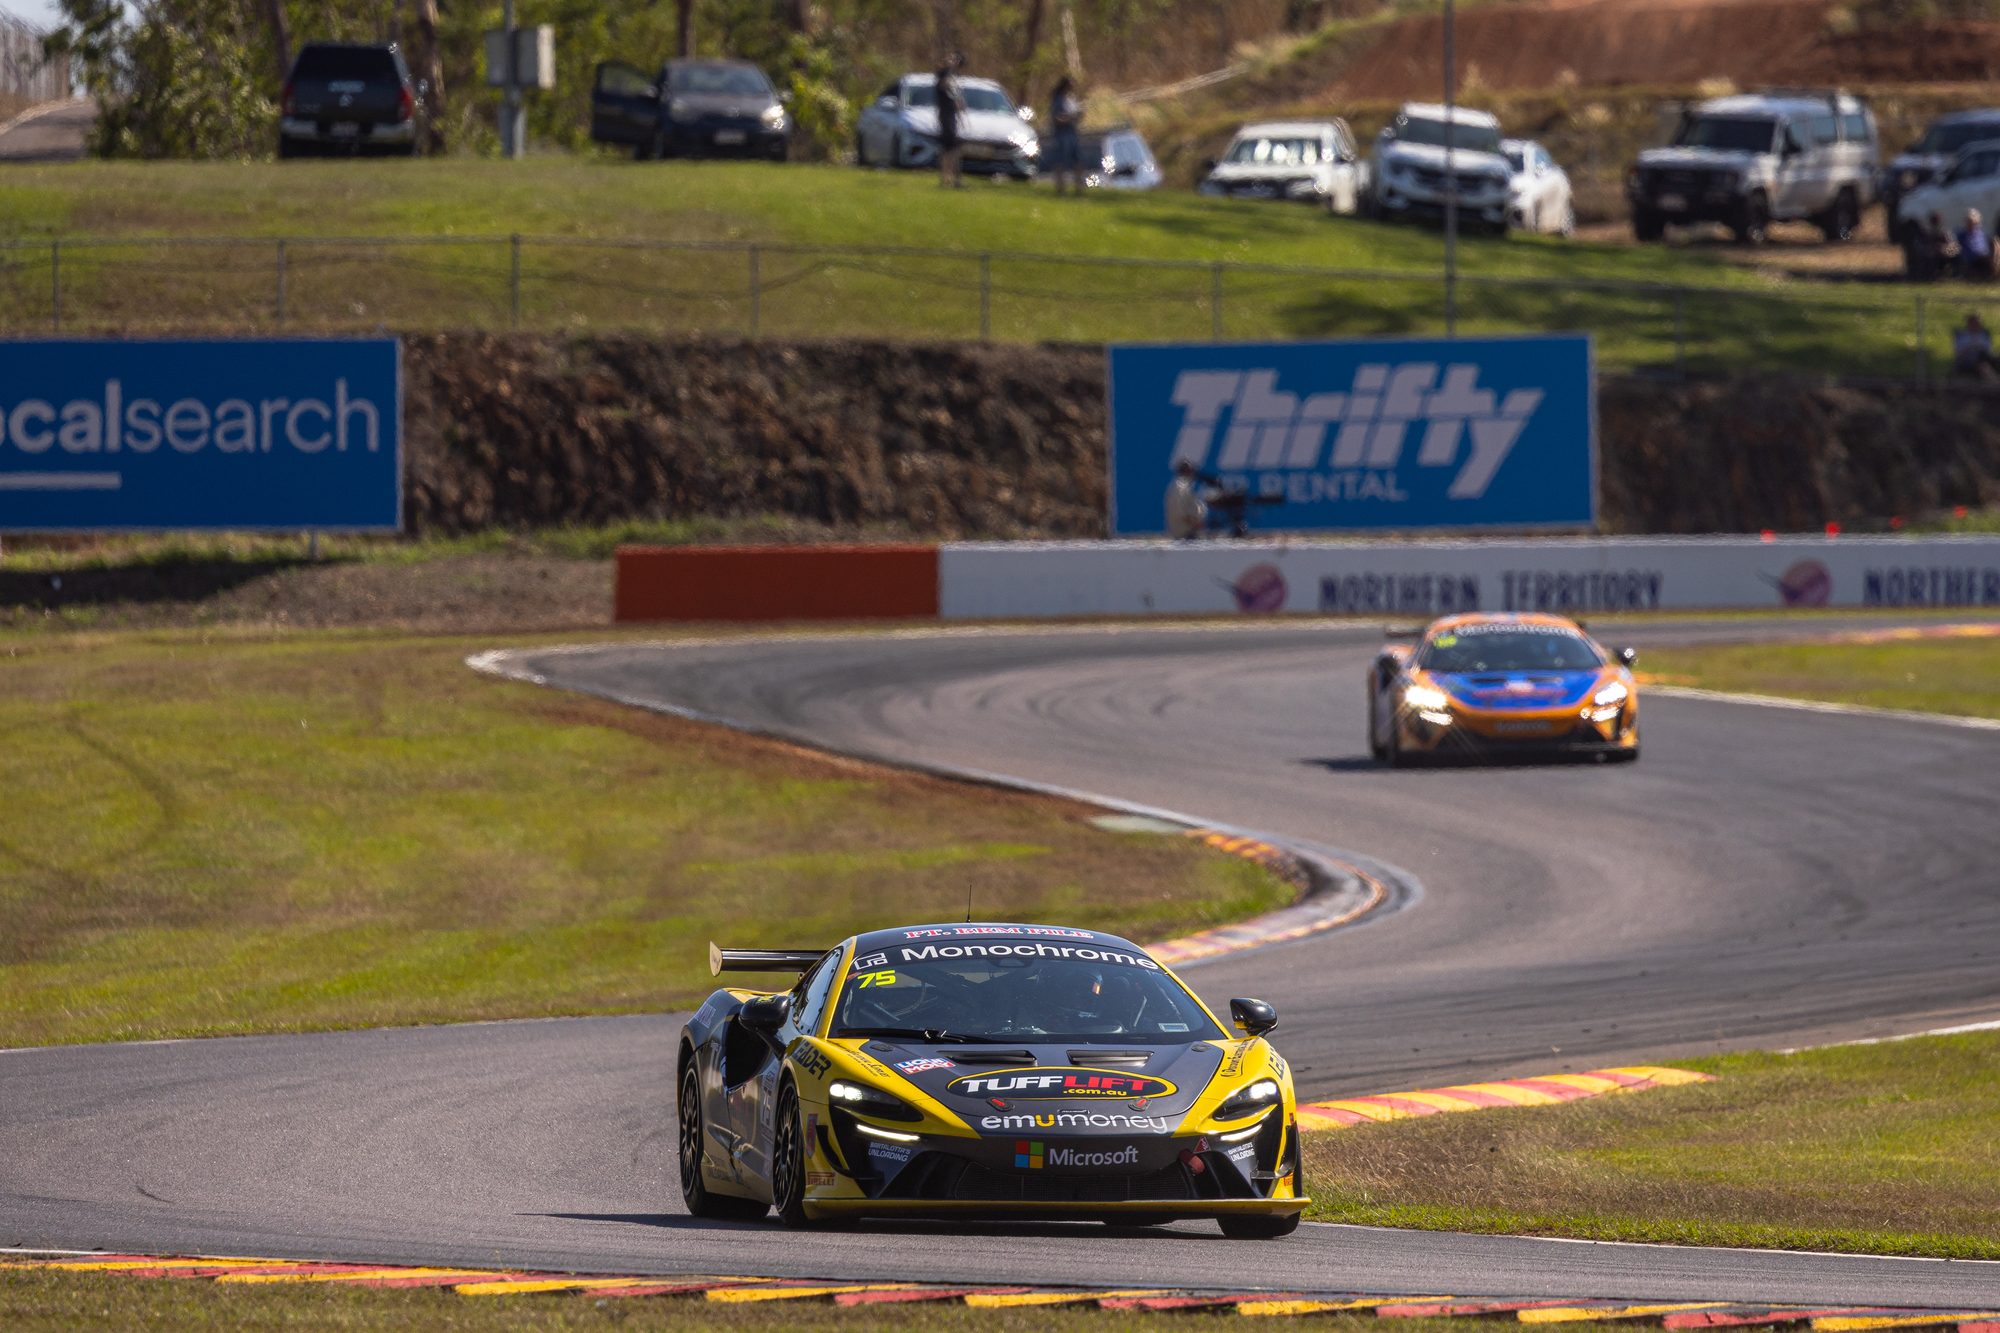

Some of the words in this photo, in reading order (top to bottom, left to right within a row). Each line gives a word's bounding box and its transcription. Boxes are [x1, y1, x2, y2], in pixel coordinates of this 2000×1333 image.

[0, 377, 380, 453] calsearch
[1168, 363, 1546, 499] Thrifty
[1258, 470, 1408, 503] RENTAL
[901, 943, 1158, 969] Monochrome
[857, 969, 896, 989] 75
[904, 1063, 953, 1074] MOLY
[1063, 1088, 1127, 1096] .com.au
[981, 1113, 1168, 1134] emumoney
[868, 1149, 908, 1162] UNLOADING
[1050, 1145, 1138, 1167] Microsoft
